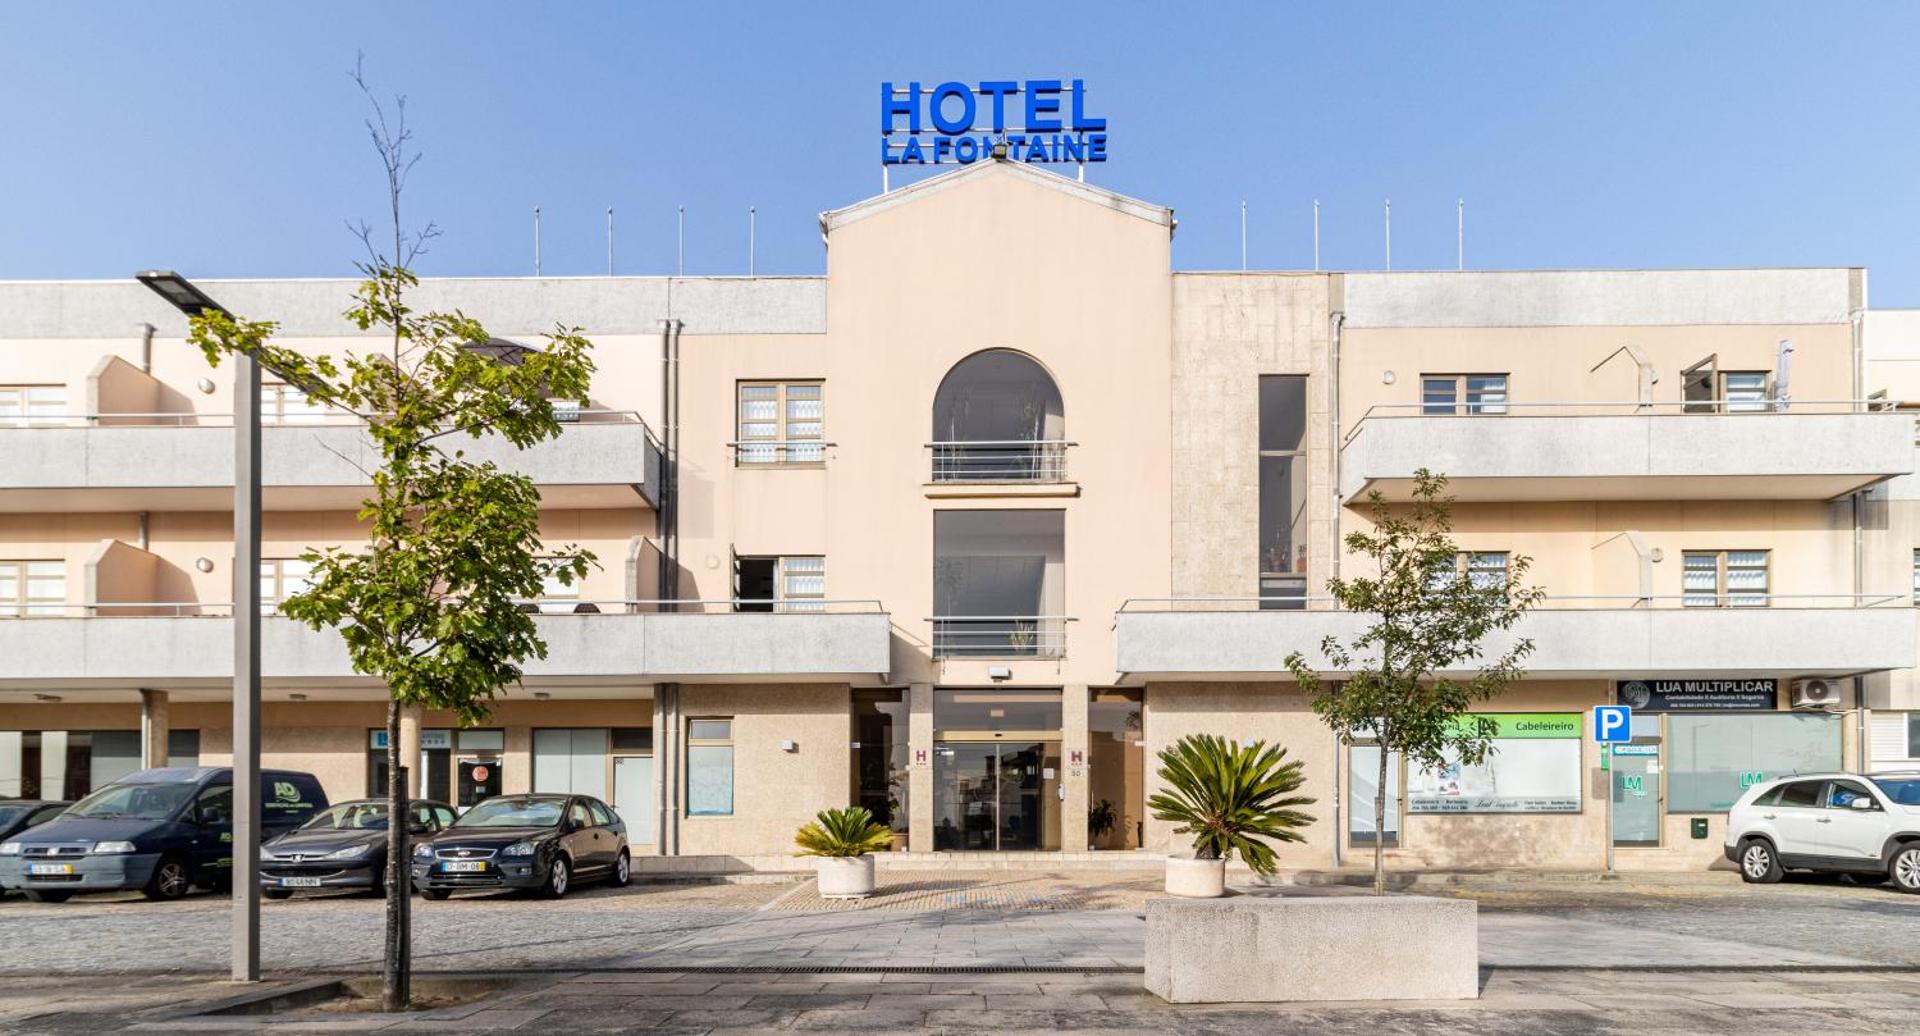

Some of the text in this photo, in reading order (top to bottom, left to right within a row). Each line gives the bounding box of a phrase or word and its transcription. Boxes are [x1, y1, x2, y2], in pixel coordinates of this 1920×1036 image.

[881, 79, 1107, 136] HOTEL
[1656, 681, 1774, 693] LUA MULTIPLICAR
[1516, 721, 1574, 731] Cabeleireiro
[1601, 708, 1624, 740] P
[916, 750, 926, 762] H
[1071, 751, 1082, 762] H
